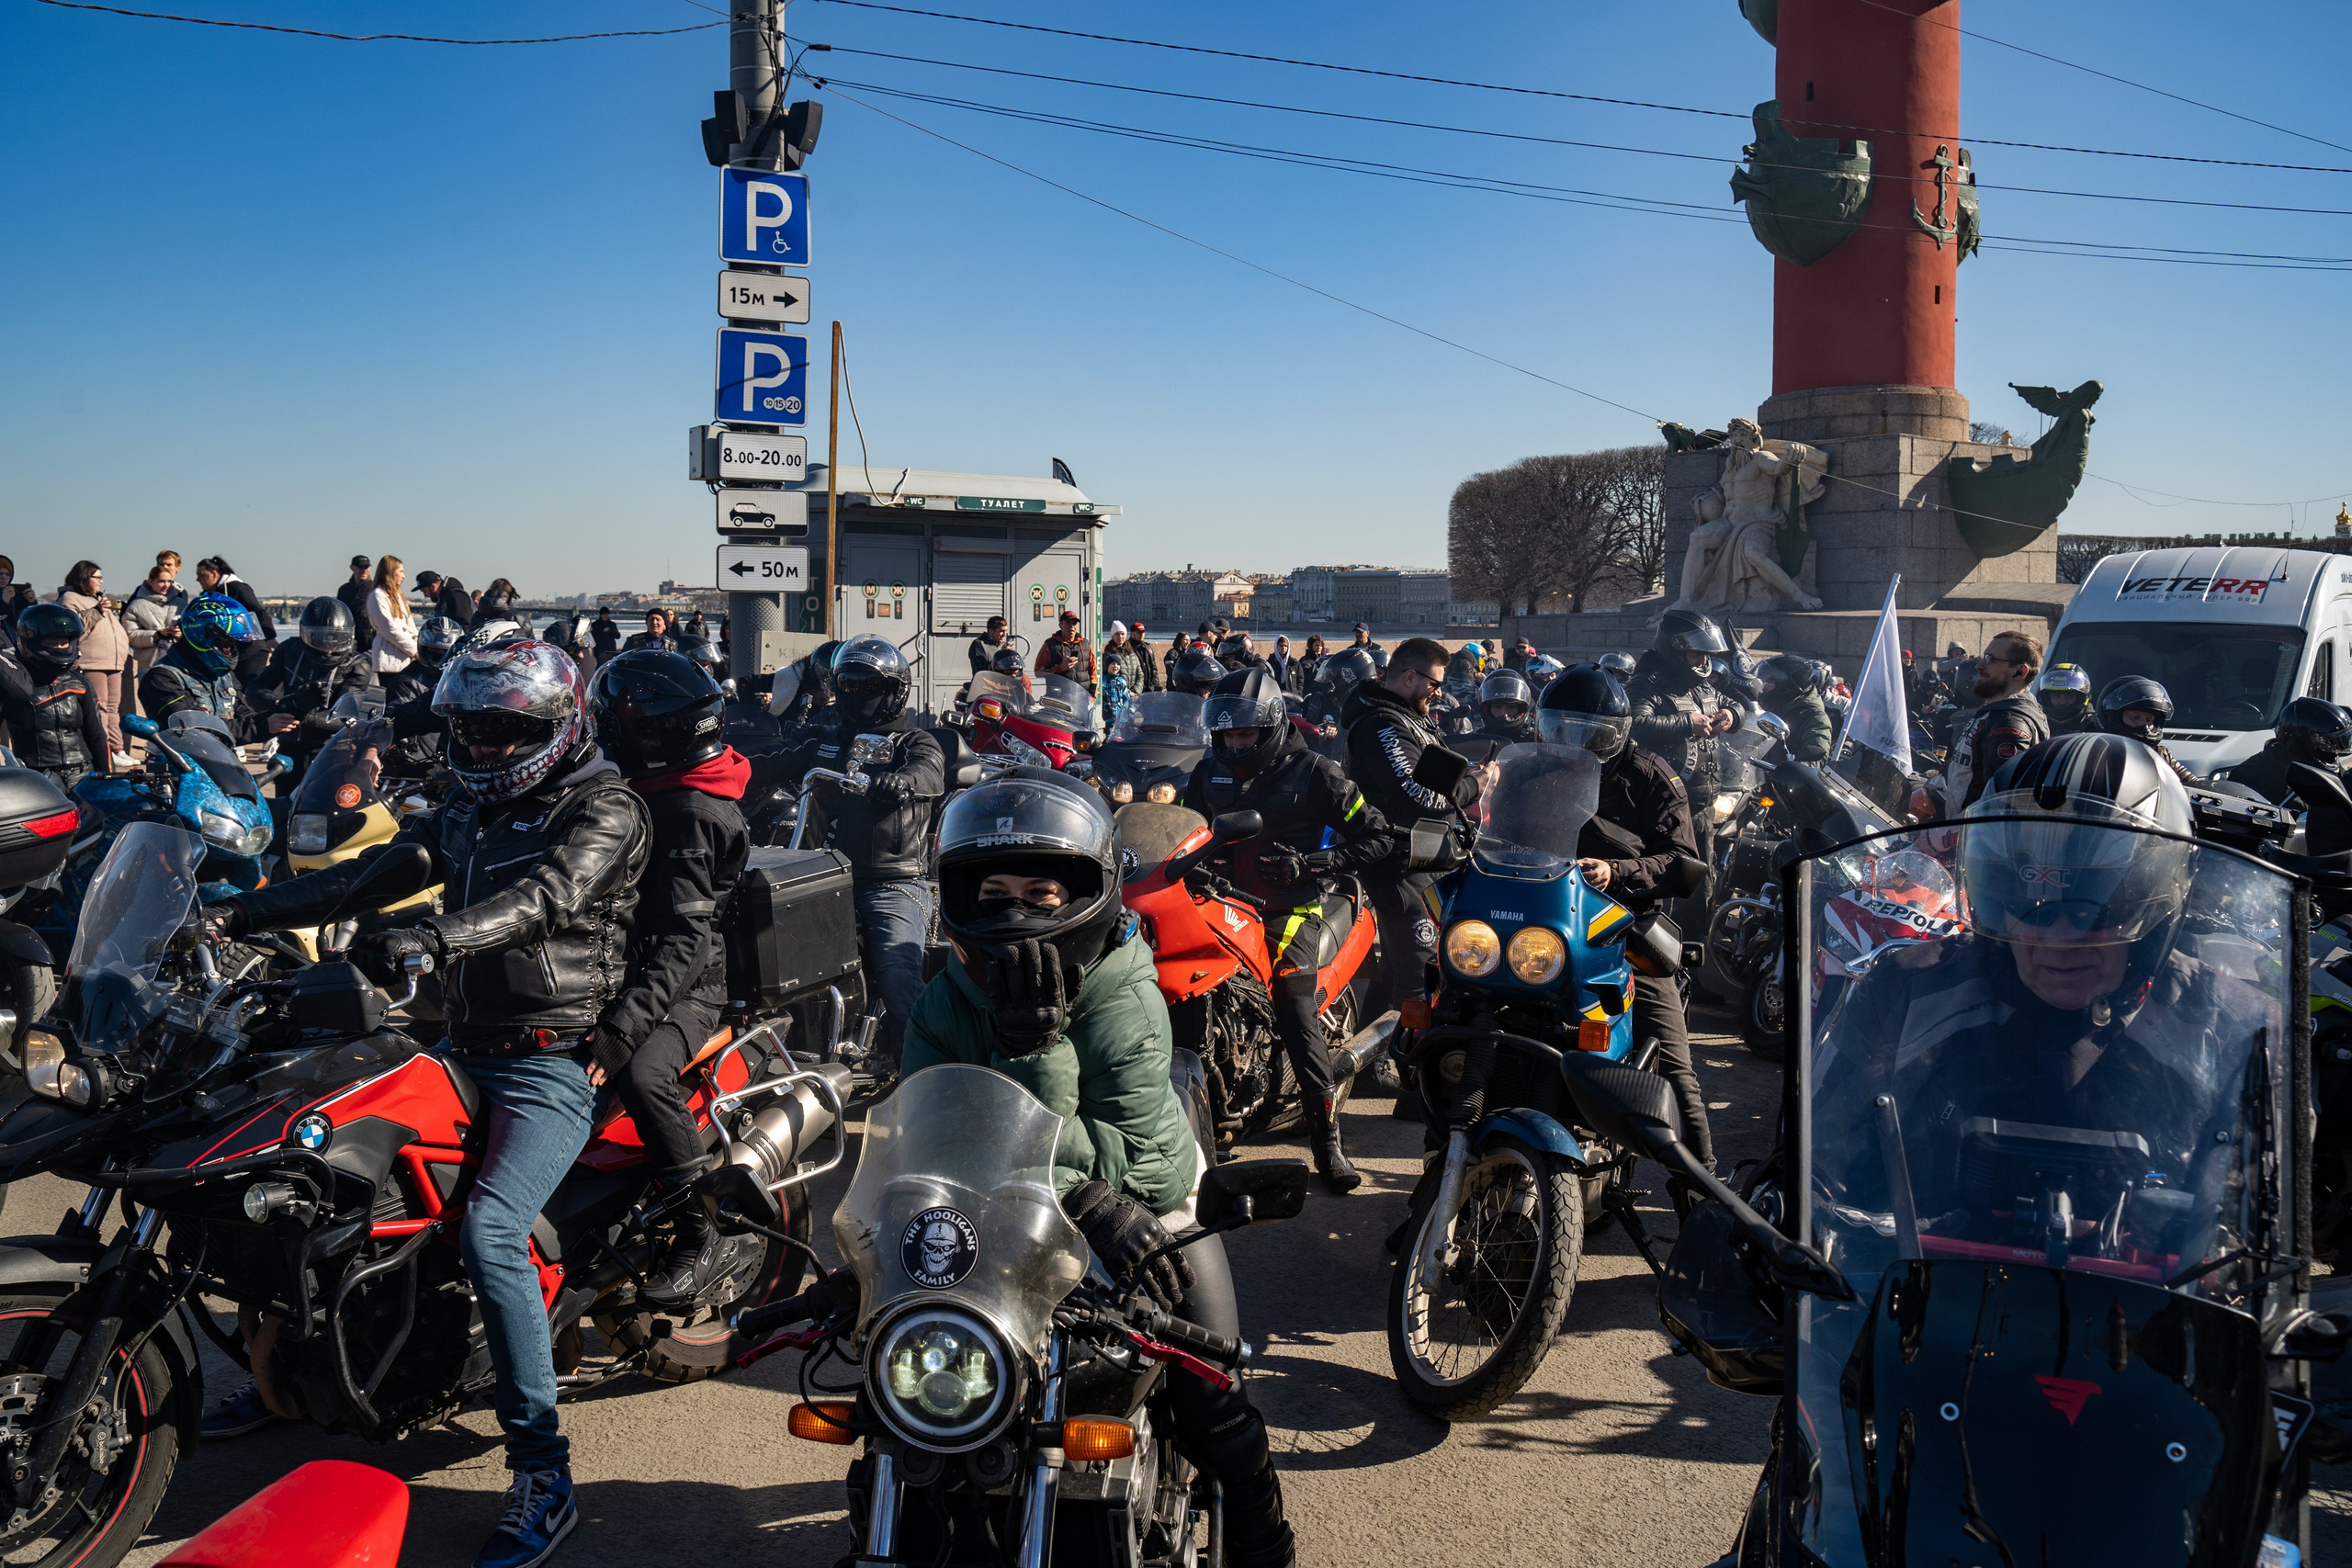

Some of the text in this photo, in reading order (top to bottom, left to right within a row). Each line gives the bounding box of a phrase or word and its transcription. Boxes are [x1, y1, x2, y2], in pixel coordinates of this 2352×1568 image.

[746, 180, 793, 252] P
[742, 341, 791, 412] P
[775, 399, 784, 409] 15
[786, 398, 800, 412] 20
[723, 447, 802, 467] 8.00-20.00
[980, 499, 1025, 509] ТУАЛЕТ
[2120, 577, 2267, 595] VETERR
[2117, 592, 2192, 603] ОФИЦИАЛЬНЫЙ
[2198, 593, 2232, 602] ДИЛЕР
[699, 717, 716, 729] SHOEI
[1376, 726, 1413, 777] NORMANS
[1683, 744, 1698, 776] RUSS
[976, 834, 1035, 848] SHARK
[668, 848, 706, 859] LS2
[2018, 864, 2071, 888] GXT
[1490, 909, 1524, 922] YAMAHA
[1862, 900, 1938, 931] REPSOL
[1232, 919, 1250, 933] HONDA
[2317, 928, 2341, 942] VOGE
[296, 1117, 326, 1134] BMW
[904, 1211, 976, 1251] THE HOOLIGANS
[914, 1269, 956, 1286] FAMILY
[1214, 1412, 1247, 1433] BILTEMA
